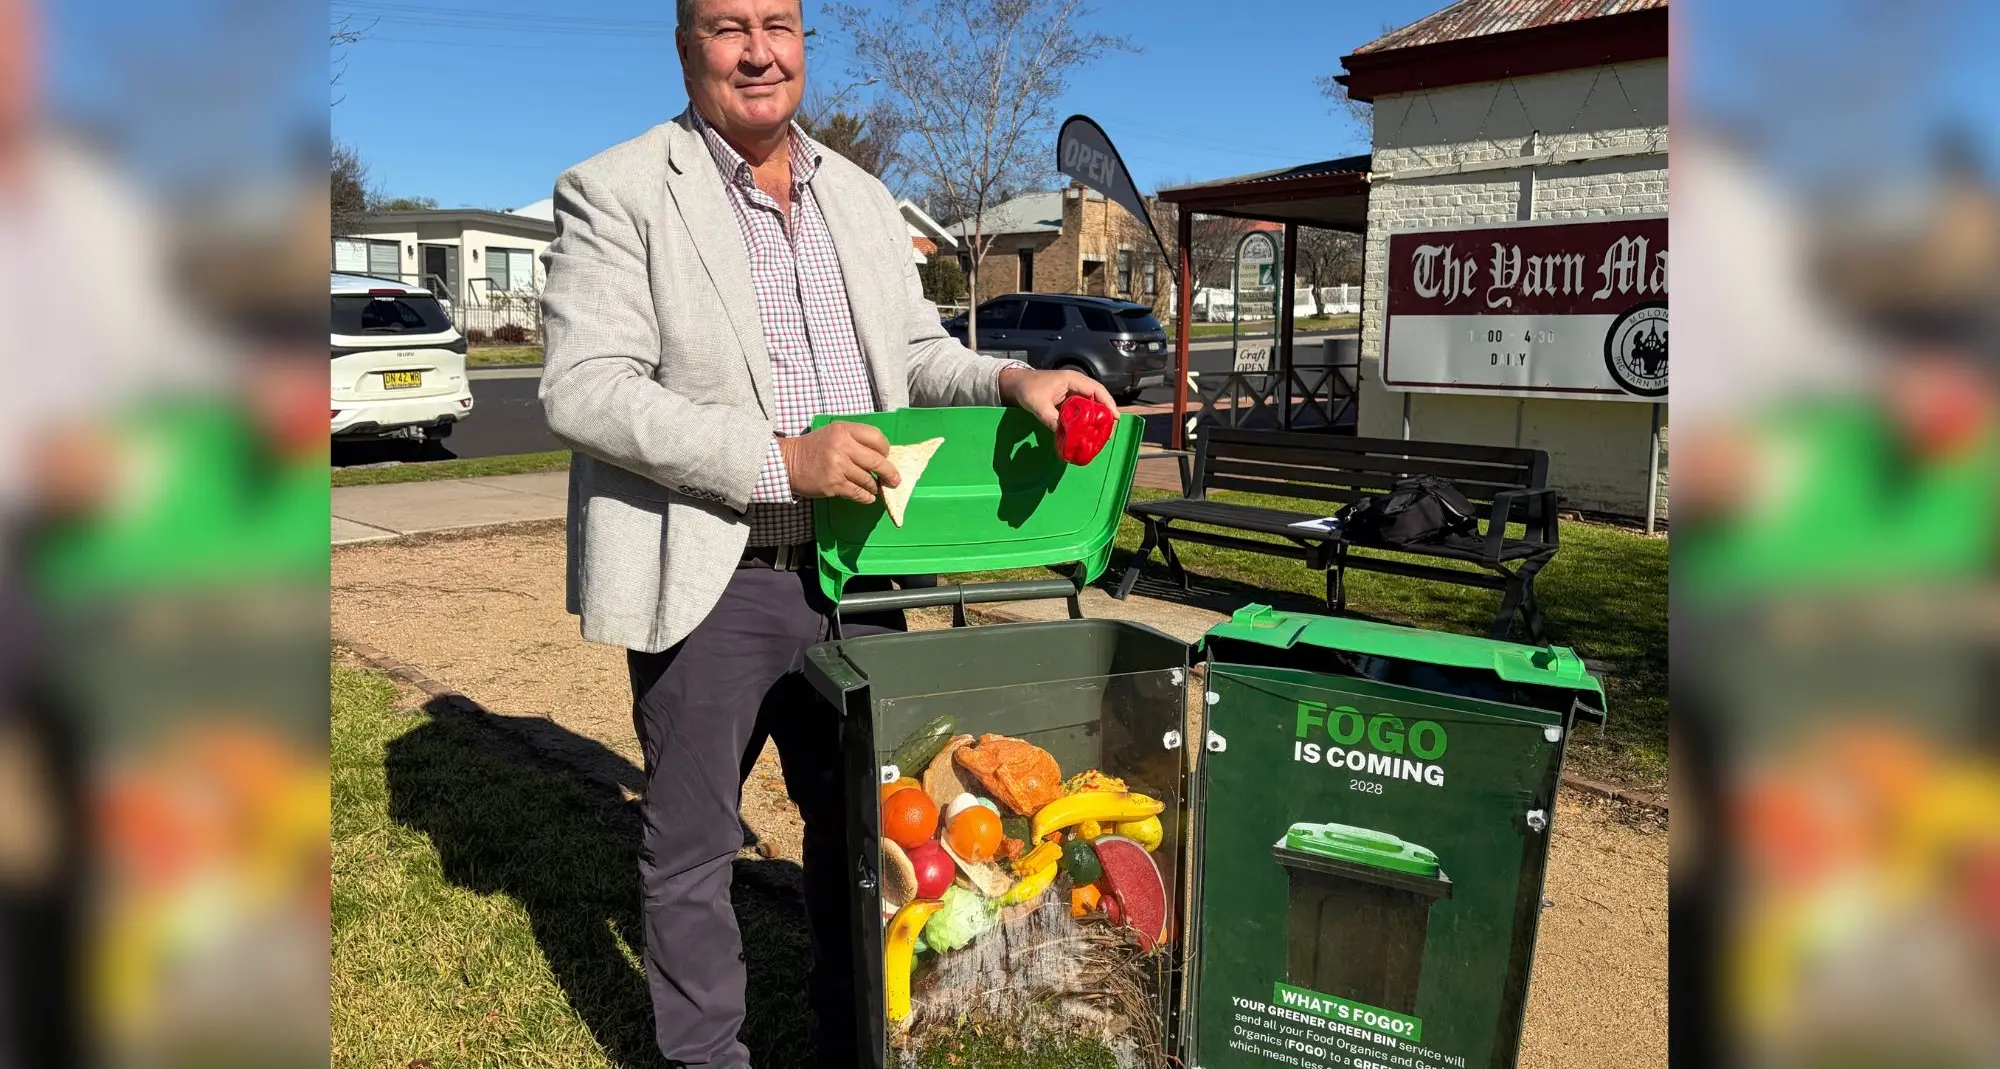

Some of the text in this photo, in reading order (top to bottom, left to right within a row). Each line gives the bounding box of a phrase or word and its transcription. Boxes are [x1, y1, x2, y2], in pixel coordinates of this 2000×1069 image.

[1065, 138, 1116, 188] OPEN
[1411, 243, 1479, 305] The
[1486, 242, 1587, 308] Yarn
[1237, 363, 1266, 371] OPEN
[1240, 348, 1266, 362] Craft
[1626, 372, 1650, 387] YARN
[1295, 699, 1447, 760] FOGO
[1294, 741, 1445, 787] IS COMING
[1350, 778, 1383, 795] 2028
[1232, 996, 1266, 1013] YOUR
[1268, 1005, 1326, 1029] GREENER
[1328, 1020, 1371, 1041] GREEN
[1374, 1032, 1397, 1048] BIN
[1399, 1042, 1441, 1060] service
[1444, 1055, 1465, 1068] will
[1281, 989, 1414, 1036] WHAT'S FOGO?
[1229, 1039, 1260, 1055] which
[1263, 1048, 1299, 1065] means
[1234, 1025, 1392, 1069] Organics (FOGO) to a GRE
[1235, 1013, 1261, 1026] send
[1263, 1020, 1277, 1030] all
[1279, 1024, 1304, 1037] your
[1306, 1029, 1334, 1046] Food
[1336, 1038, 1388, 1060] Organics
[1390, 1055, 1412, 1068] and
